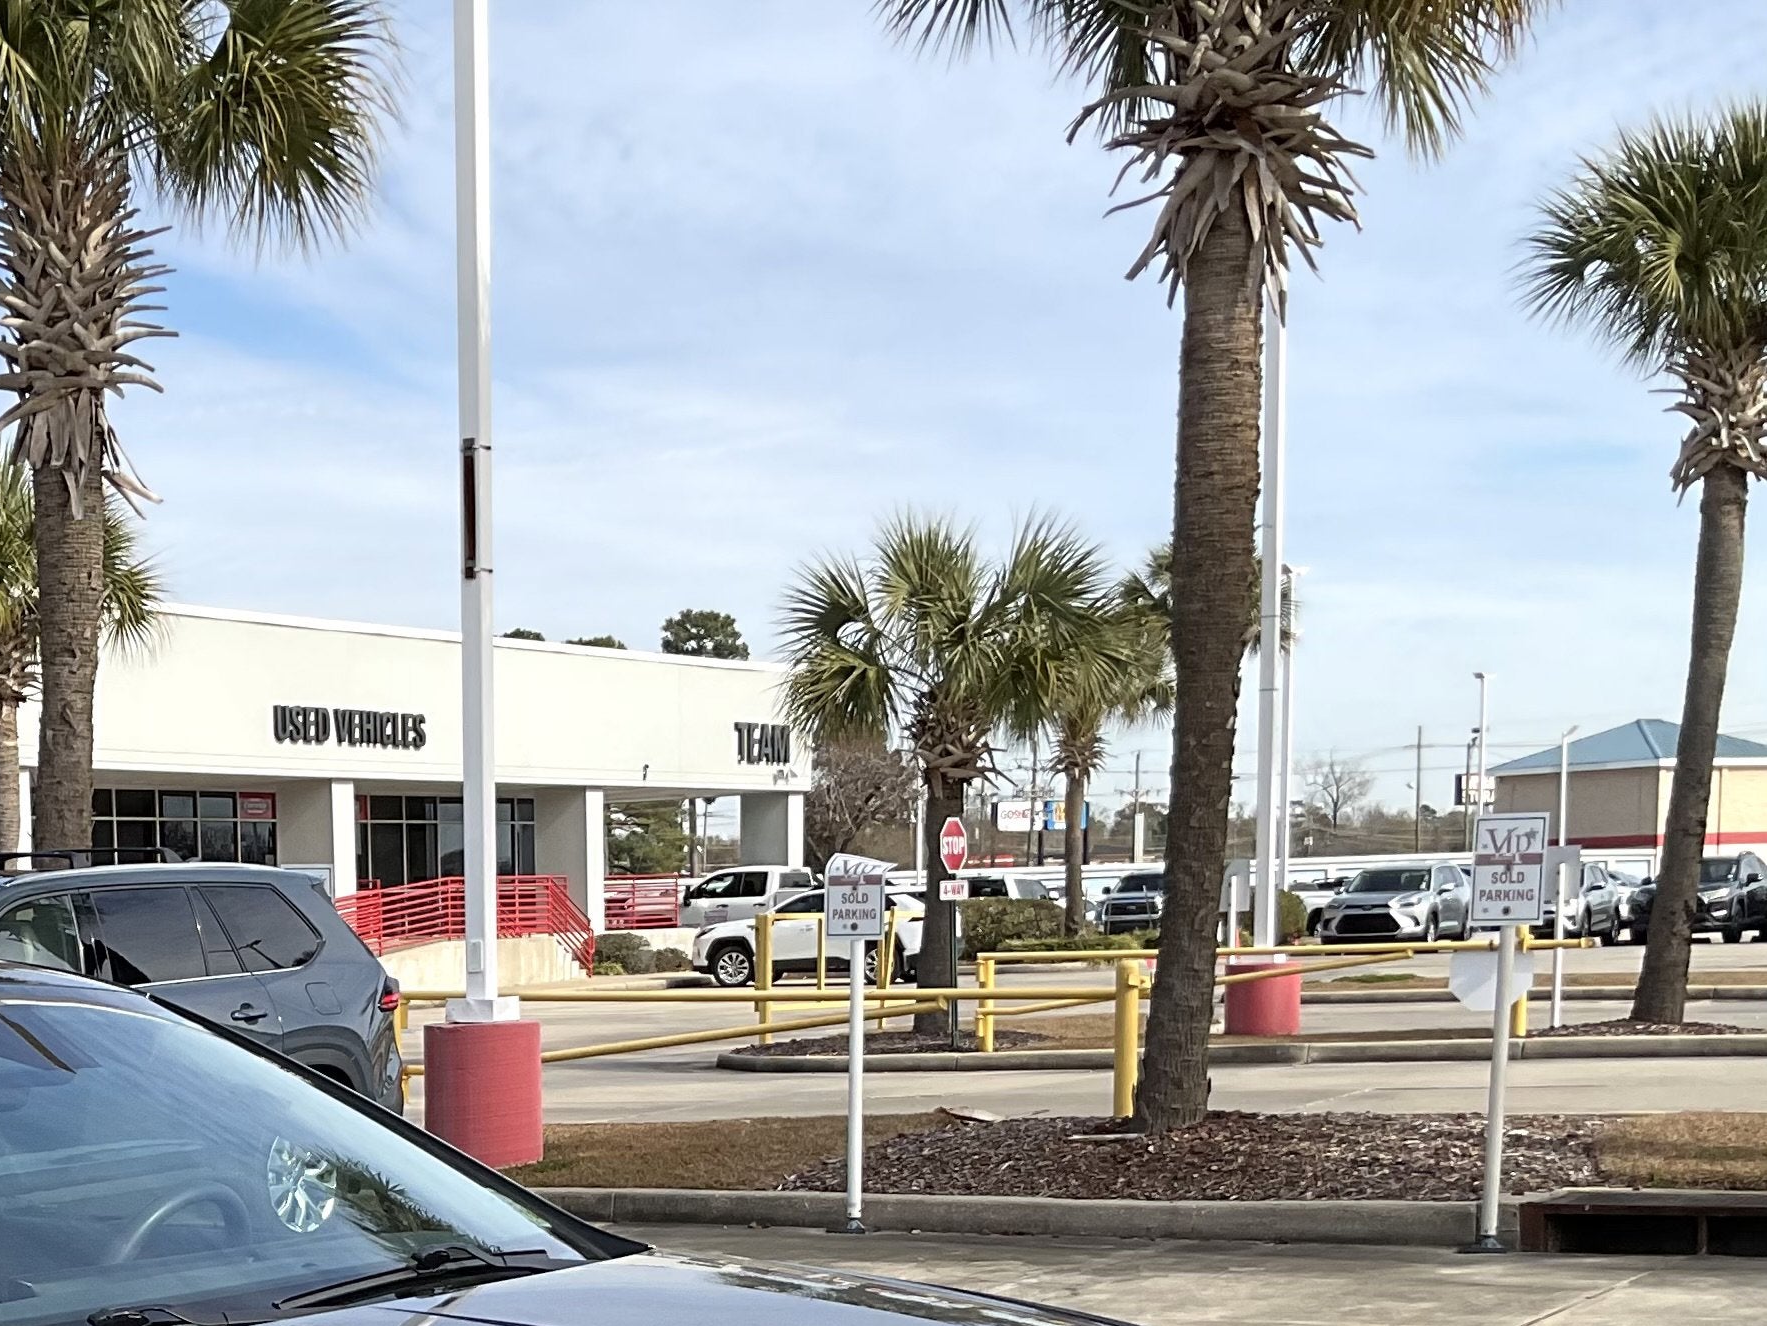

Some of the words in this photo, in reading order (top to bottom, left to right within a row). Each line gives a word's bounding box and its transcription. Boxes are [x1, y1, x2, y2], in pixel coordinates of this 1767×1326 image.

[272, 704, 331, 746] USED
[333, 708, 427, 751] VEHICLES
[733, 721, 791, 767] TEAM
[942, 835, 965, 855] STOP
[1490, 871, 1525, 885] SOLD
[943, 884, 965, 896] 4-WAY
[1478, 889, 1534, 902] PARKING
[841, 892, 869, 905] SOLD
[832, 908, 877, 921] PARKING
